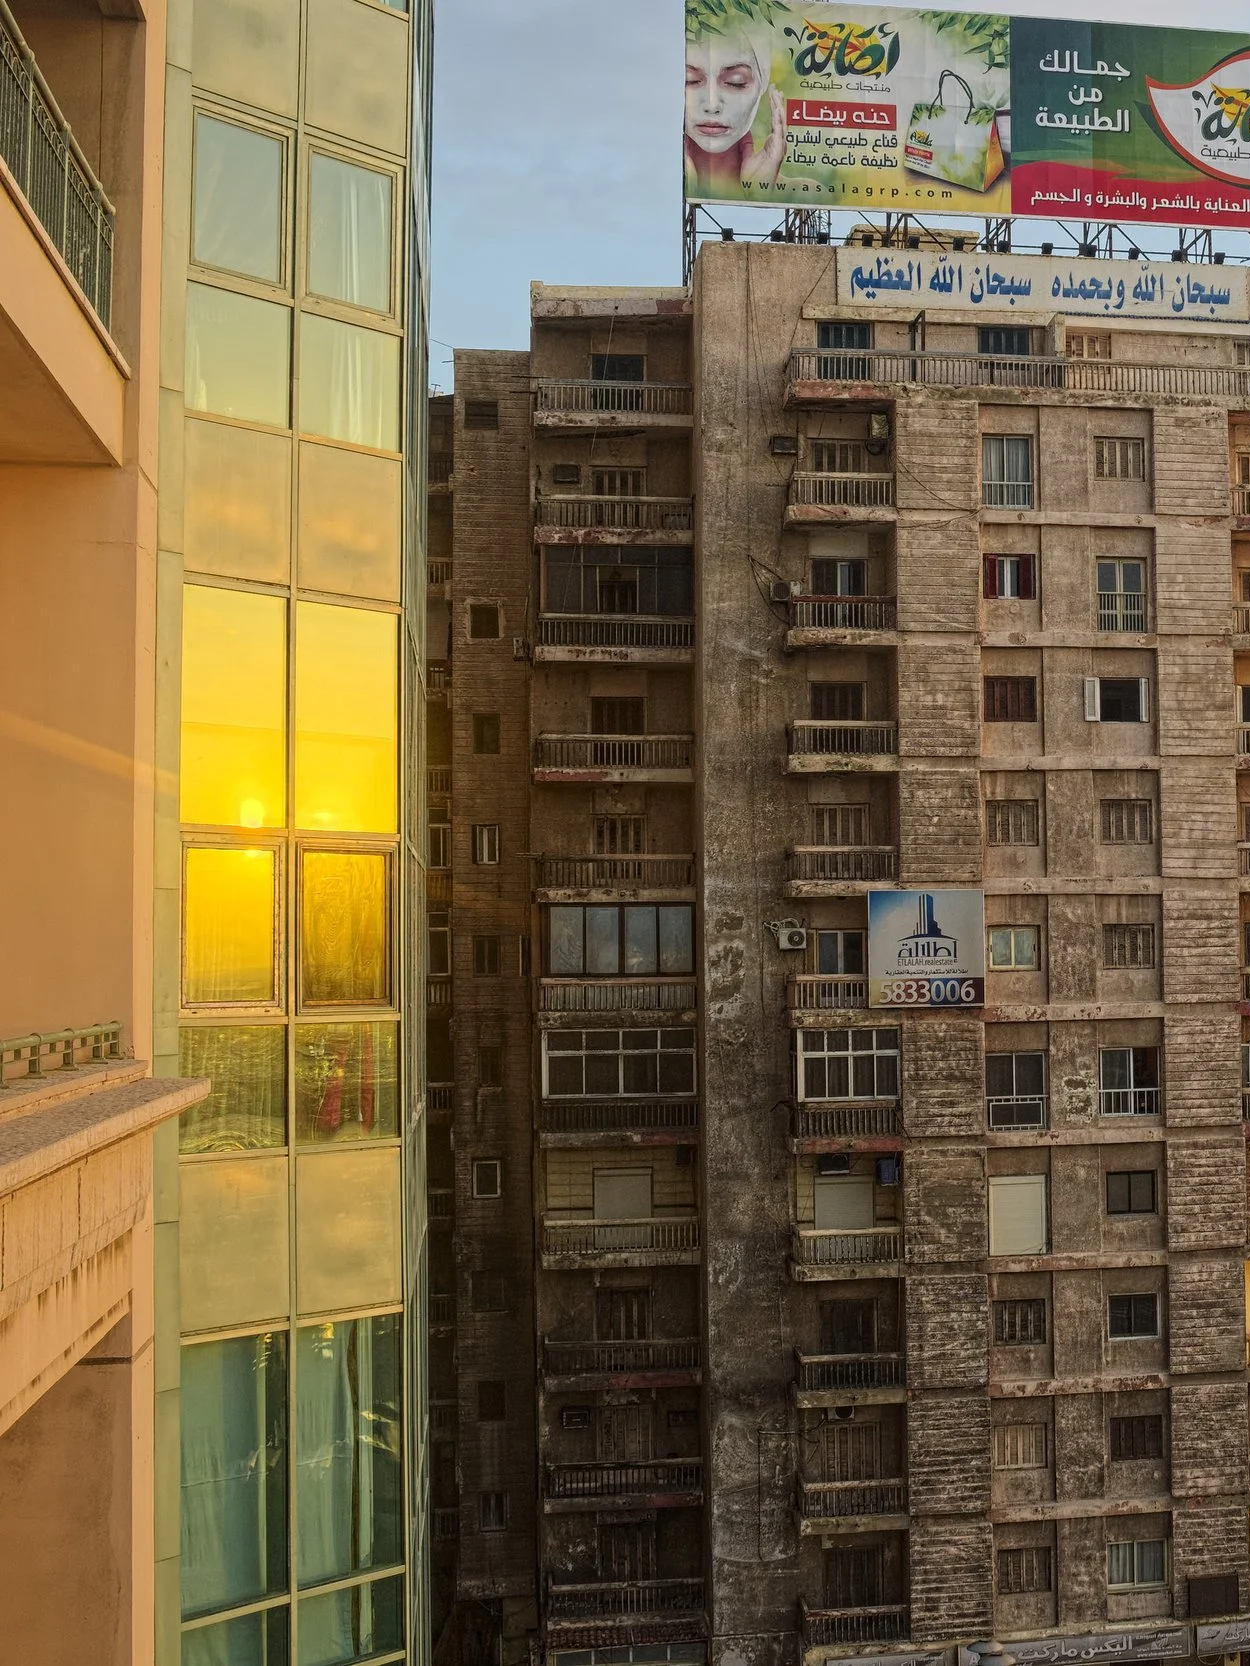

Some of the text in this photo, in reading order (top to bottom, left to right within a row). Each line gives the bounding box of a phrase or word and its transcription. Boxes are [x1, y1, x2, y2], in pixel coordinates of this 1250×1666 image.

[1038, 49, 1132, 83] جمالك
[799, 78, 891, 93] منتجات طبيعية
[1068, 83, 1103, 104] من
[791, 102, 890, 126] حنه بيضاء
[1035, 106, 1130, 136] الطبيعة
[785, 129, 898, 152] قناع طبيعي لبشرة
[785, 150, 817, 167] بيضاء
[821, 151, 856, 166] ناعمة
[860, 153, 898, 169] نظيفة
[741, 179, 954, 199] www.asalagrp.com
[1030, 188, 1081, 206] الجسم
[1084, 193, 1093, 206] و
[1096, 190, 1148, 210] والبشرة
[1151, 193, 1200, 212] بالشعر
[1204, 196, 1250, 213] العناية
[850, 255, 1231, 315] سبحان الله وبحمده سبحان الله العظيم
[879, 979, 976, 1004] 5833006
[1017, 1635, 1133, 1662] اليكس ماركت
